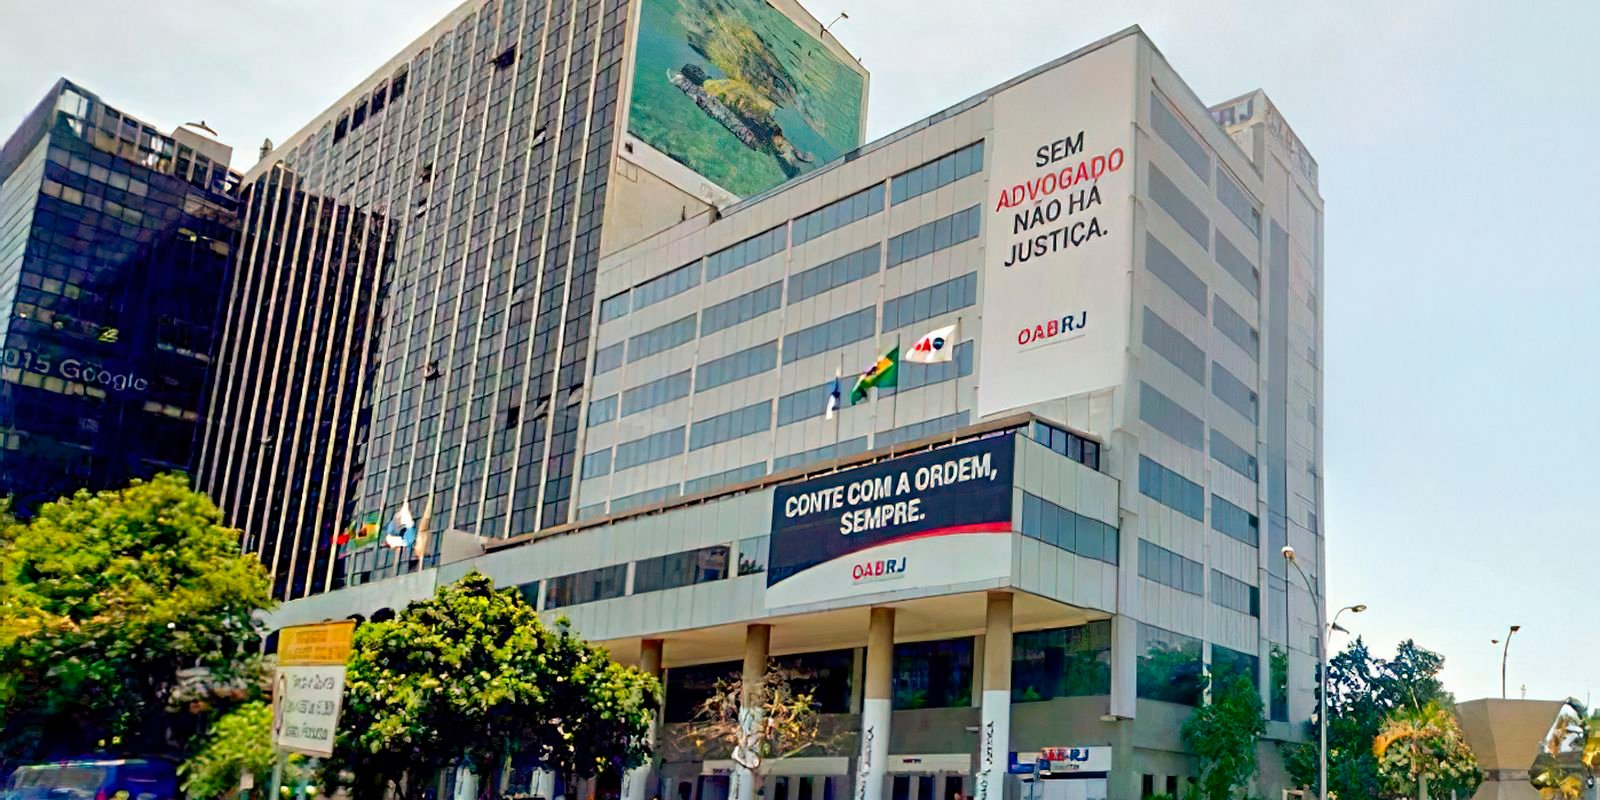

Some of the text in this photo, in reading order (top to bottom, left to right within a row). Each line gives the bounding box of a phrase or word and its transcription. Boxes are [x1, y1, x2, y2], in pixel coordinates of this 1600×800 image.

[1036, 131, 1084, 168] SEM
[996, 147, 1124, 212] ADVOGADO
[1013, 177, 1102, 234] NÃO HÁ
[1004, 217, 1108, 267] JUSTIÇA.
[1017, 311, 1087, 345] OABRJ
[785, 452, 998, 518] CONTE COM A ORDEM,
[840, 498, 926, 535] SEMPRE.
[852, 557, 907, 580] OABRJ
